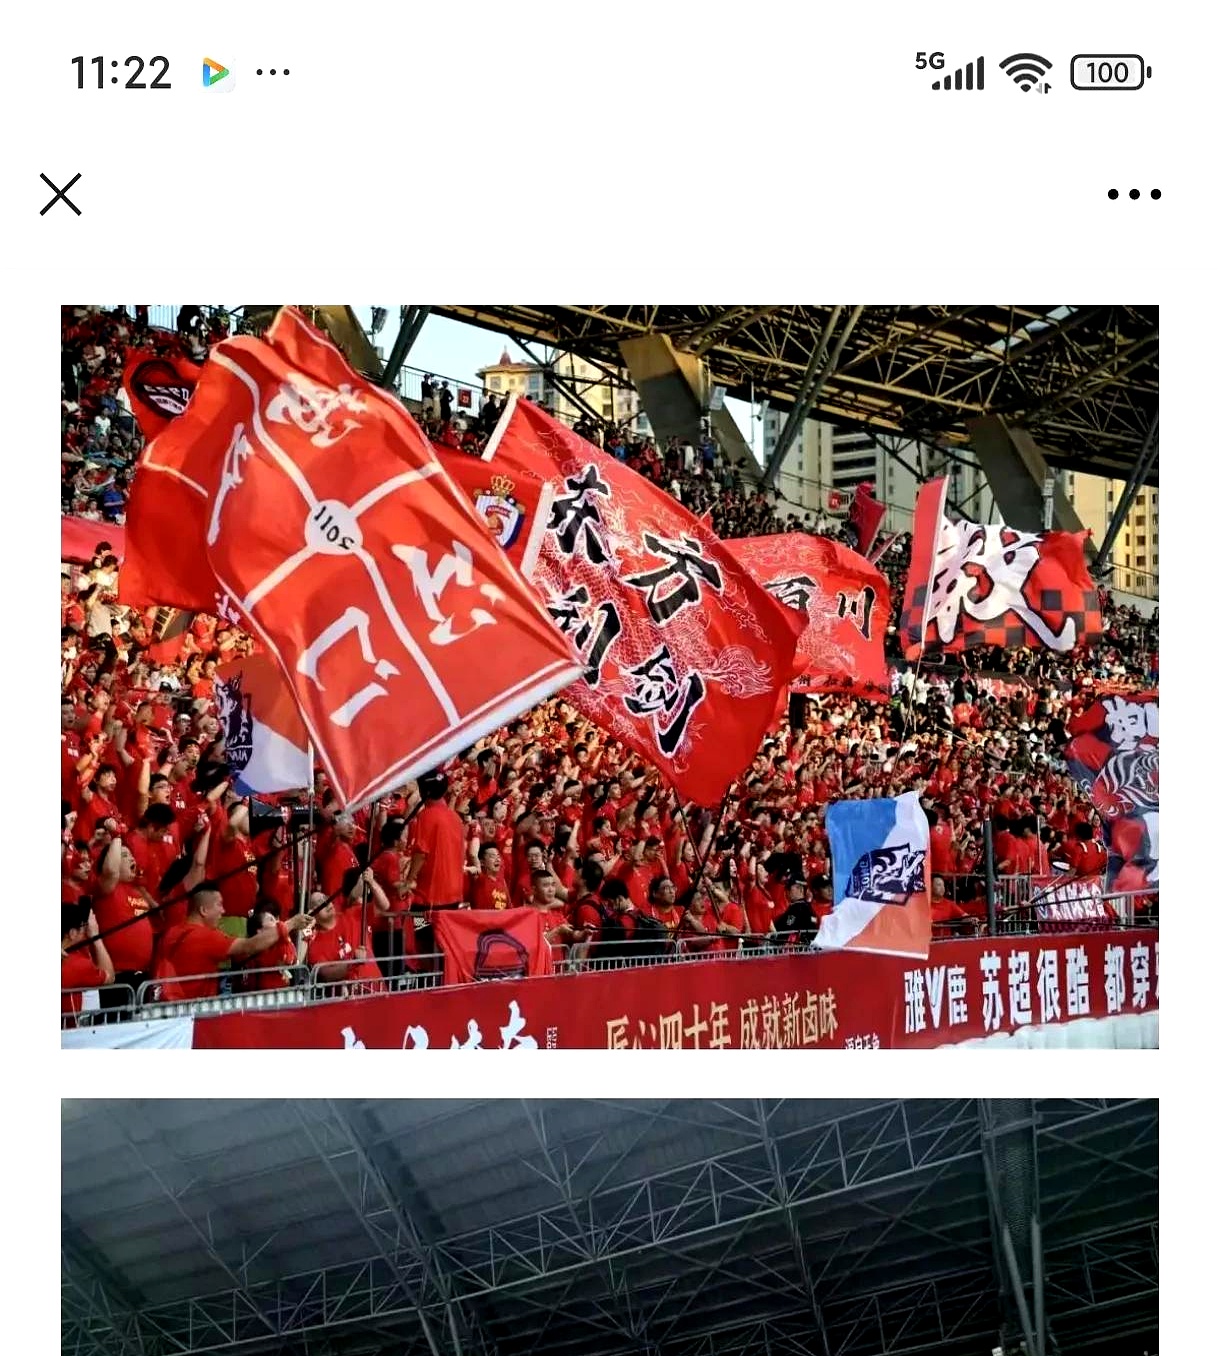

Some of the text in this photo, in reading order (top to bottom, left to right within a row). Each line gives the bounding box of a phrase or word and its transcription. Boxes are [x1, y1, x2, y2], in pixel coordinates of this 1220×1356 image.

[72, 56, 172, 89] 11:22
[916, 52, 945, 70] 5G
[1086, 62, 1129, 83] 100
[980, 940, 1159, 1032] 苏超很酷 都穿
[739, 987, 839, 1048] 成就新卤味
